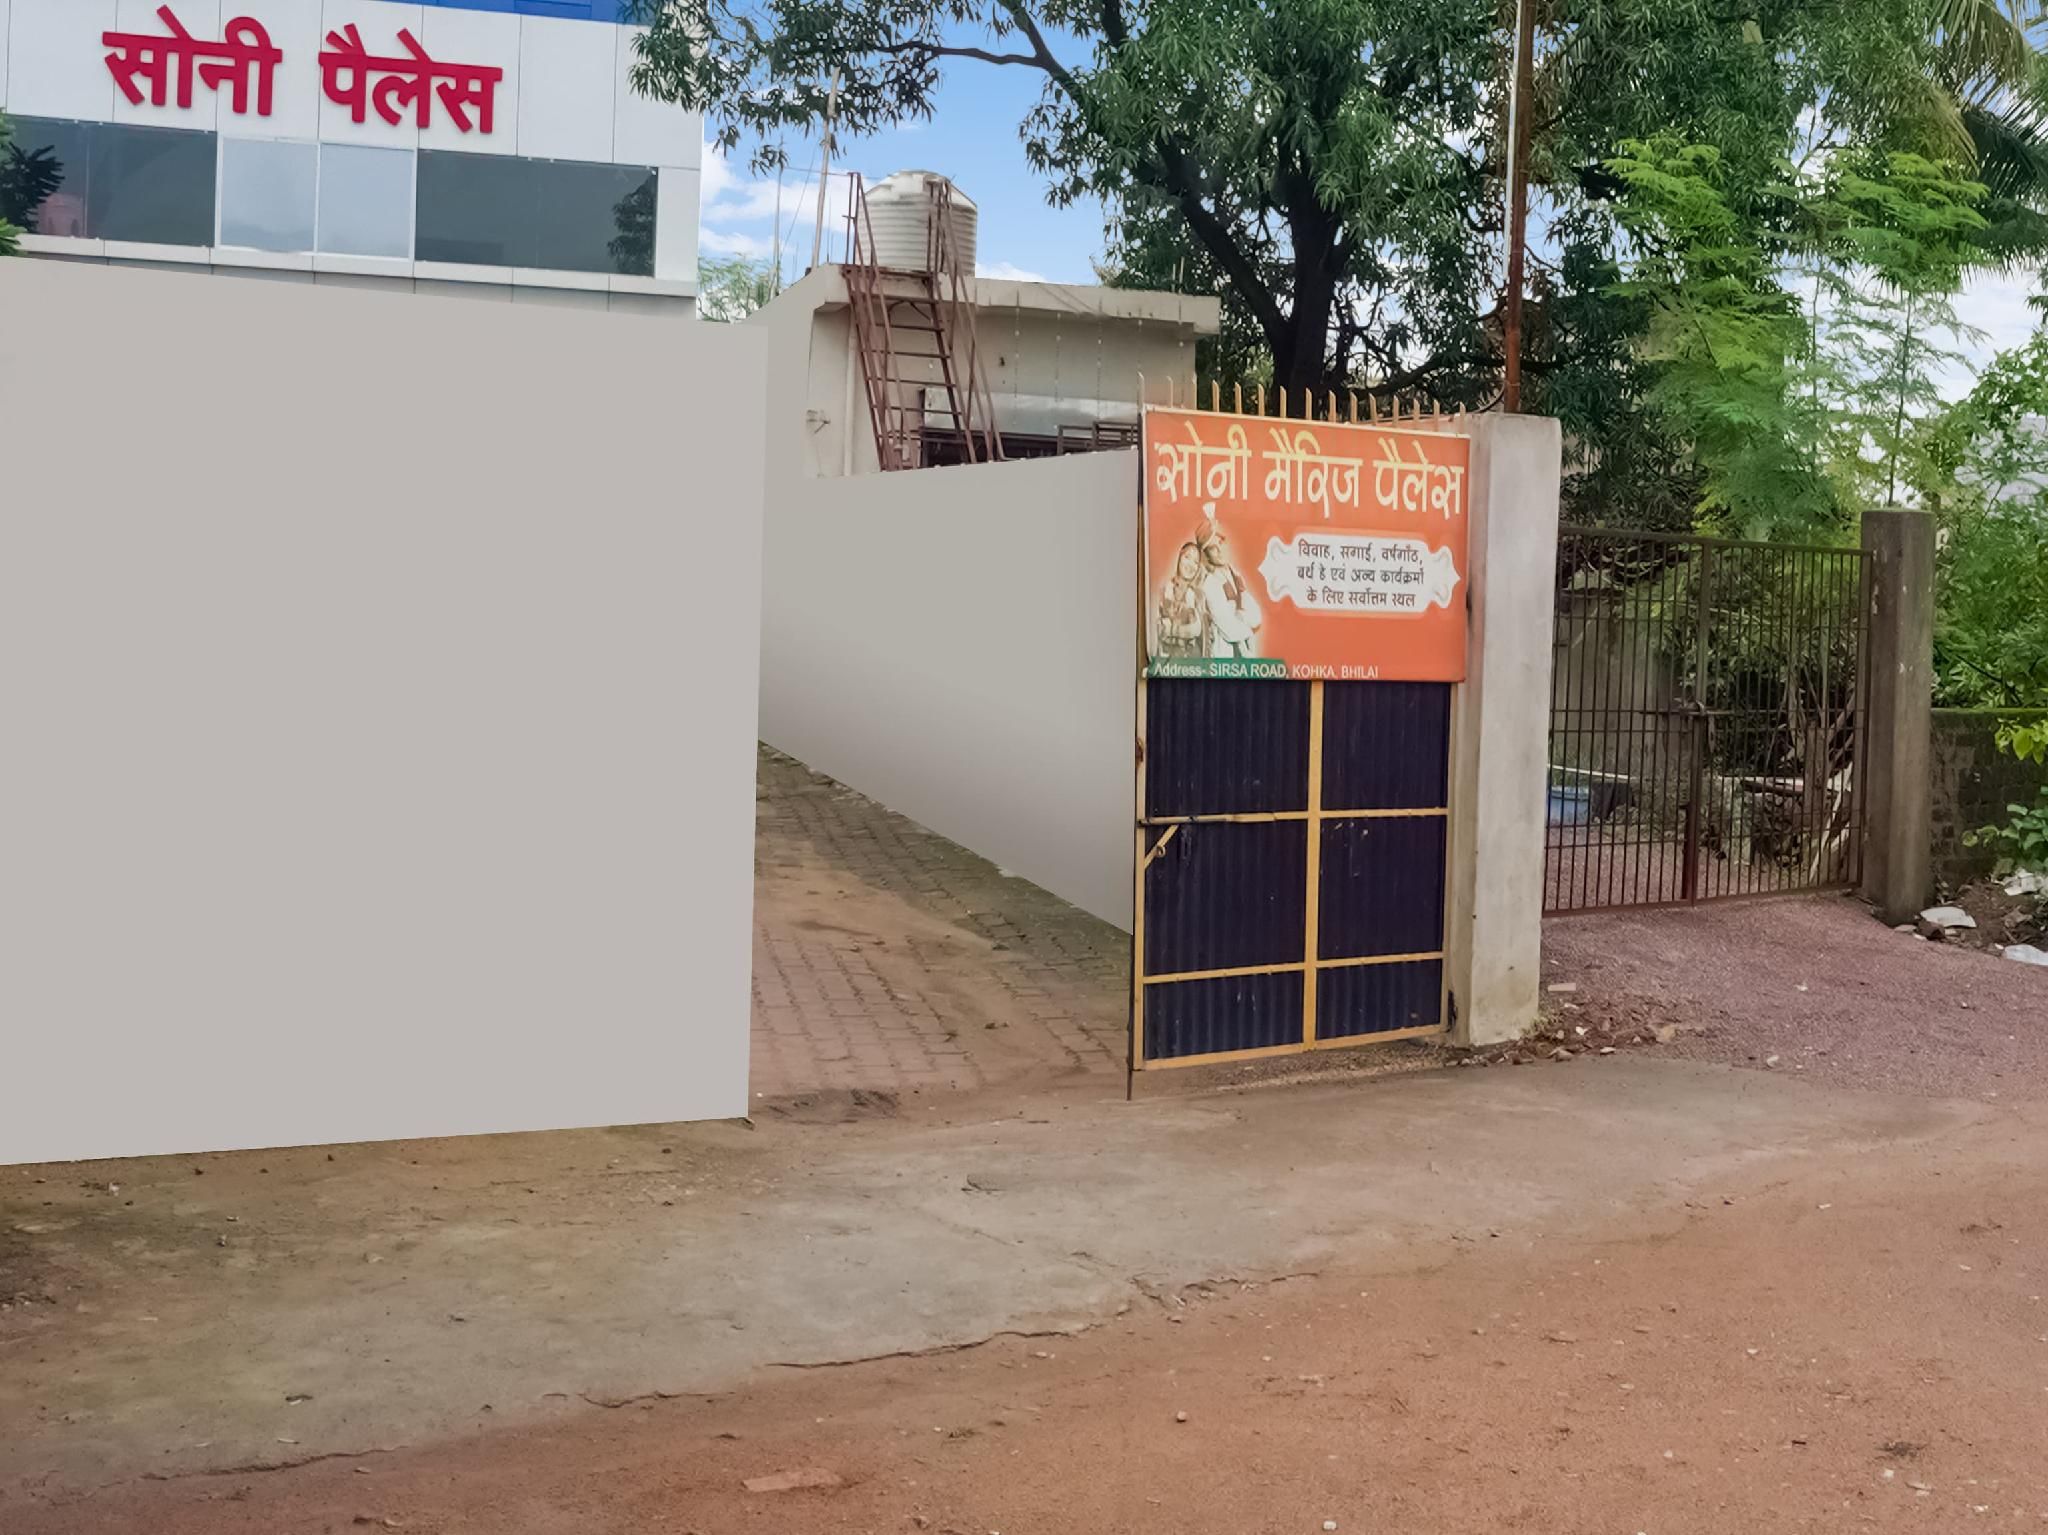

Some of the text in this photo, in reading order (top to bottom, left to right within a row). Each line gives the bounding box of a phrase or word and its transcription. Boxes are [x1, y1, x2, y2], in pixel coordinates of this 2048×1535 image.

[102, 5, 503, 134] सोनी पैलेस
[1154, 420, 1465, 520] सोनी मैरिज पैलेस
[1298, 539, 1335, 560] विवाह,
[1340, 543, 1376, 563] सगाई,
[1330, 563, 1346, 581] एवं
[1351, 570, 1376, 583] अन्य
[1306, 586, 1416, 607] के लिए सर्वोत्तम स्थल
[1208, 663, 1248, 678] SIRSA
[1250, 663, 1289, 679] ROAD,
[1341, 664, 1379, 679] BHILAI
